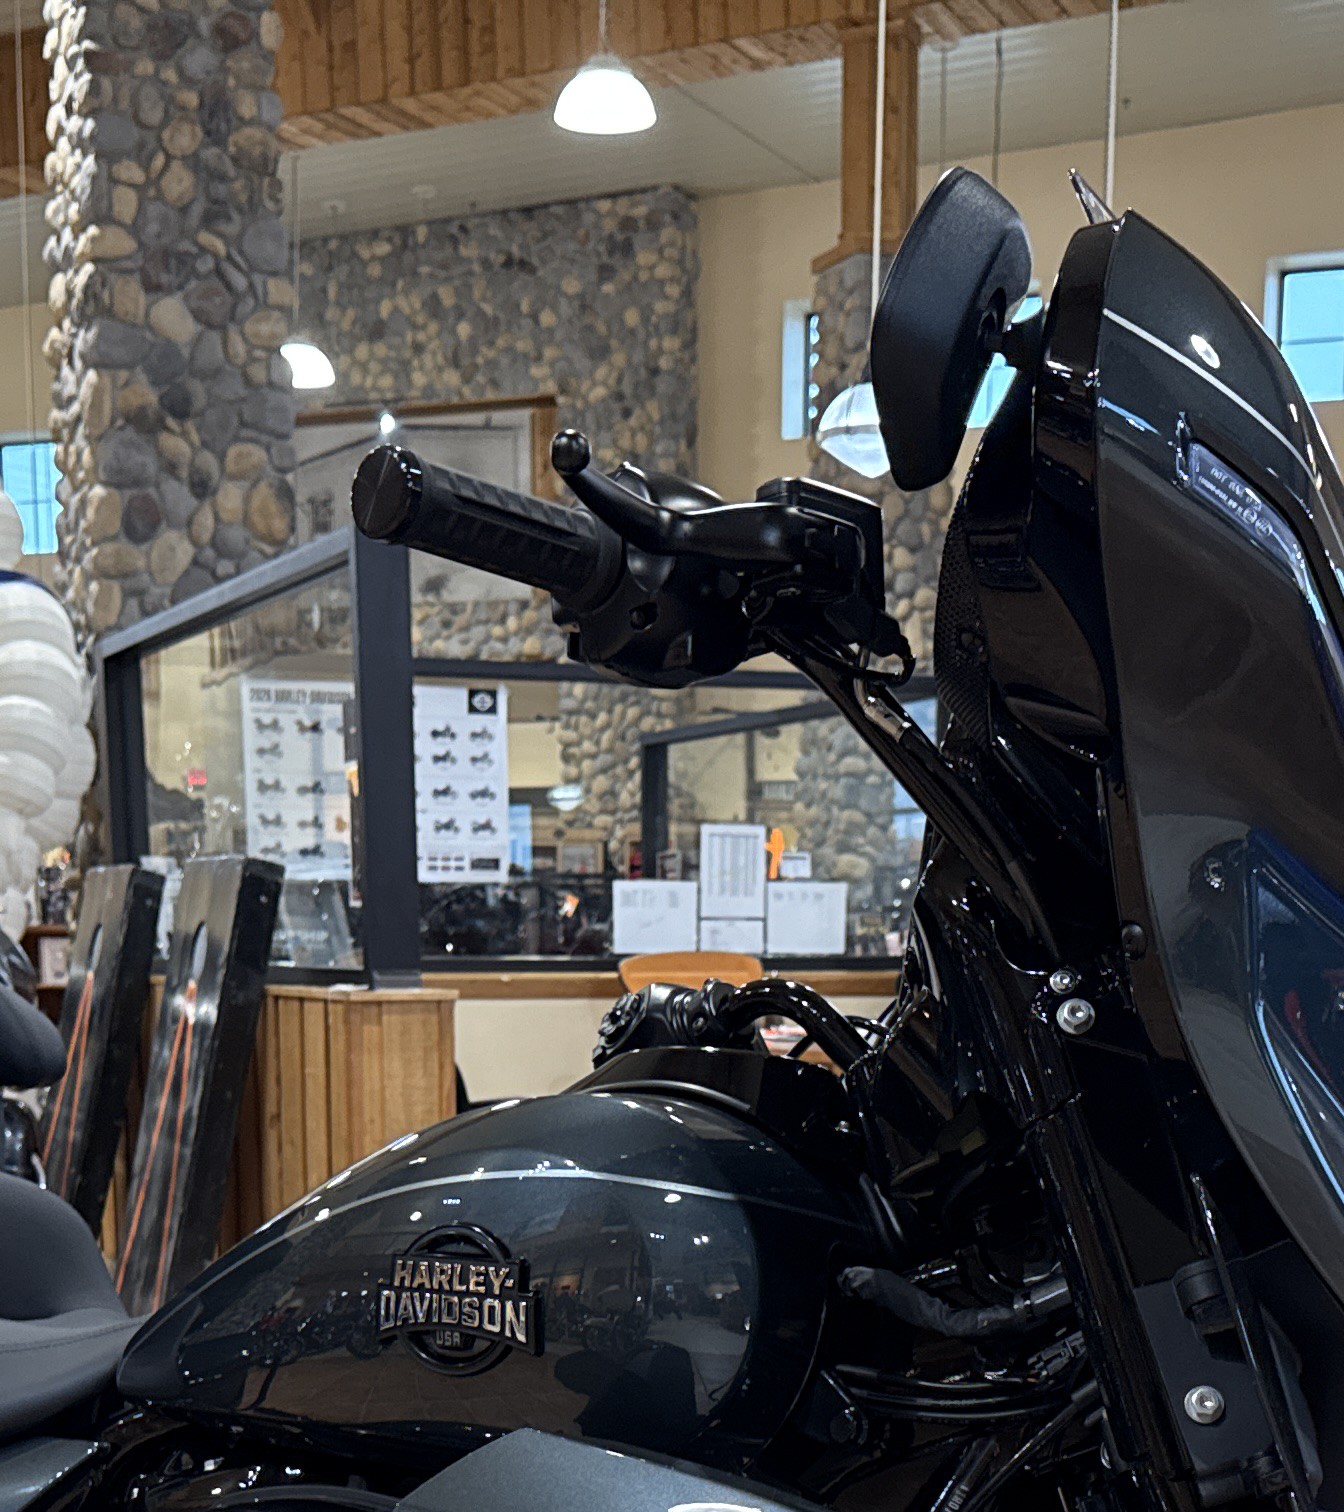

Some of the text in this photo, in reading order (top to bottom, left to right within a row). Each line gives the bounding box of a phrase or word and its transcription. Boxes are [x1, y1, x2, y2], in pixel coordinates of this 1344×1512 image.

[393, 1259, 514, 1295] HARLEY-
[379, 1290, 527, 1344] DAVIDSON
[436, 1331, 461, 1346] USA
